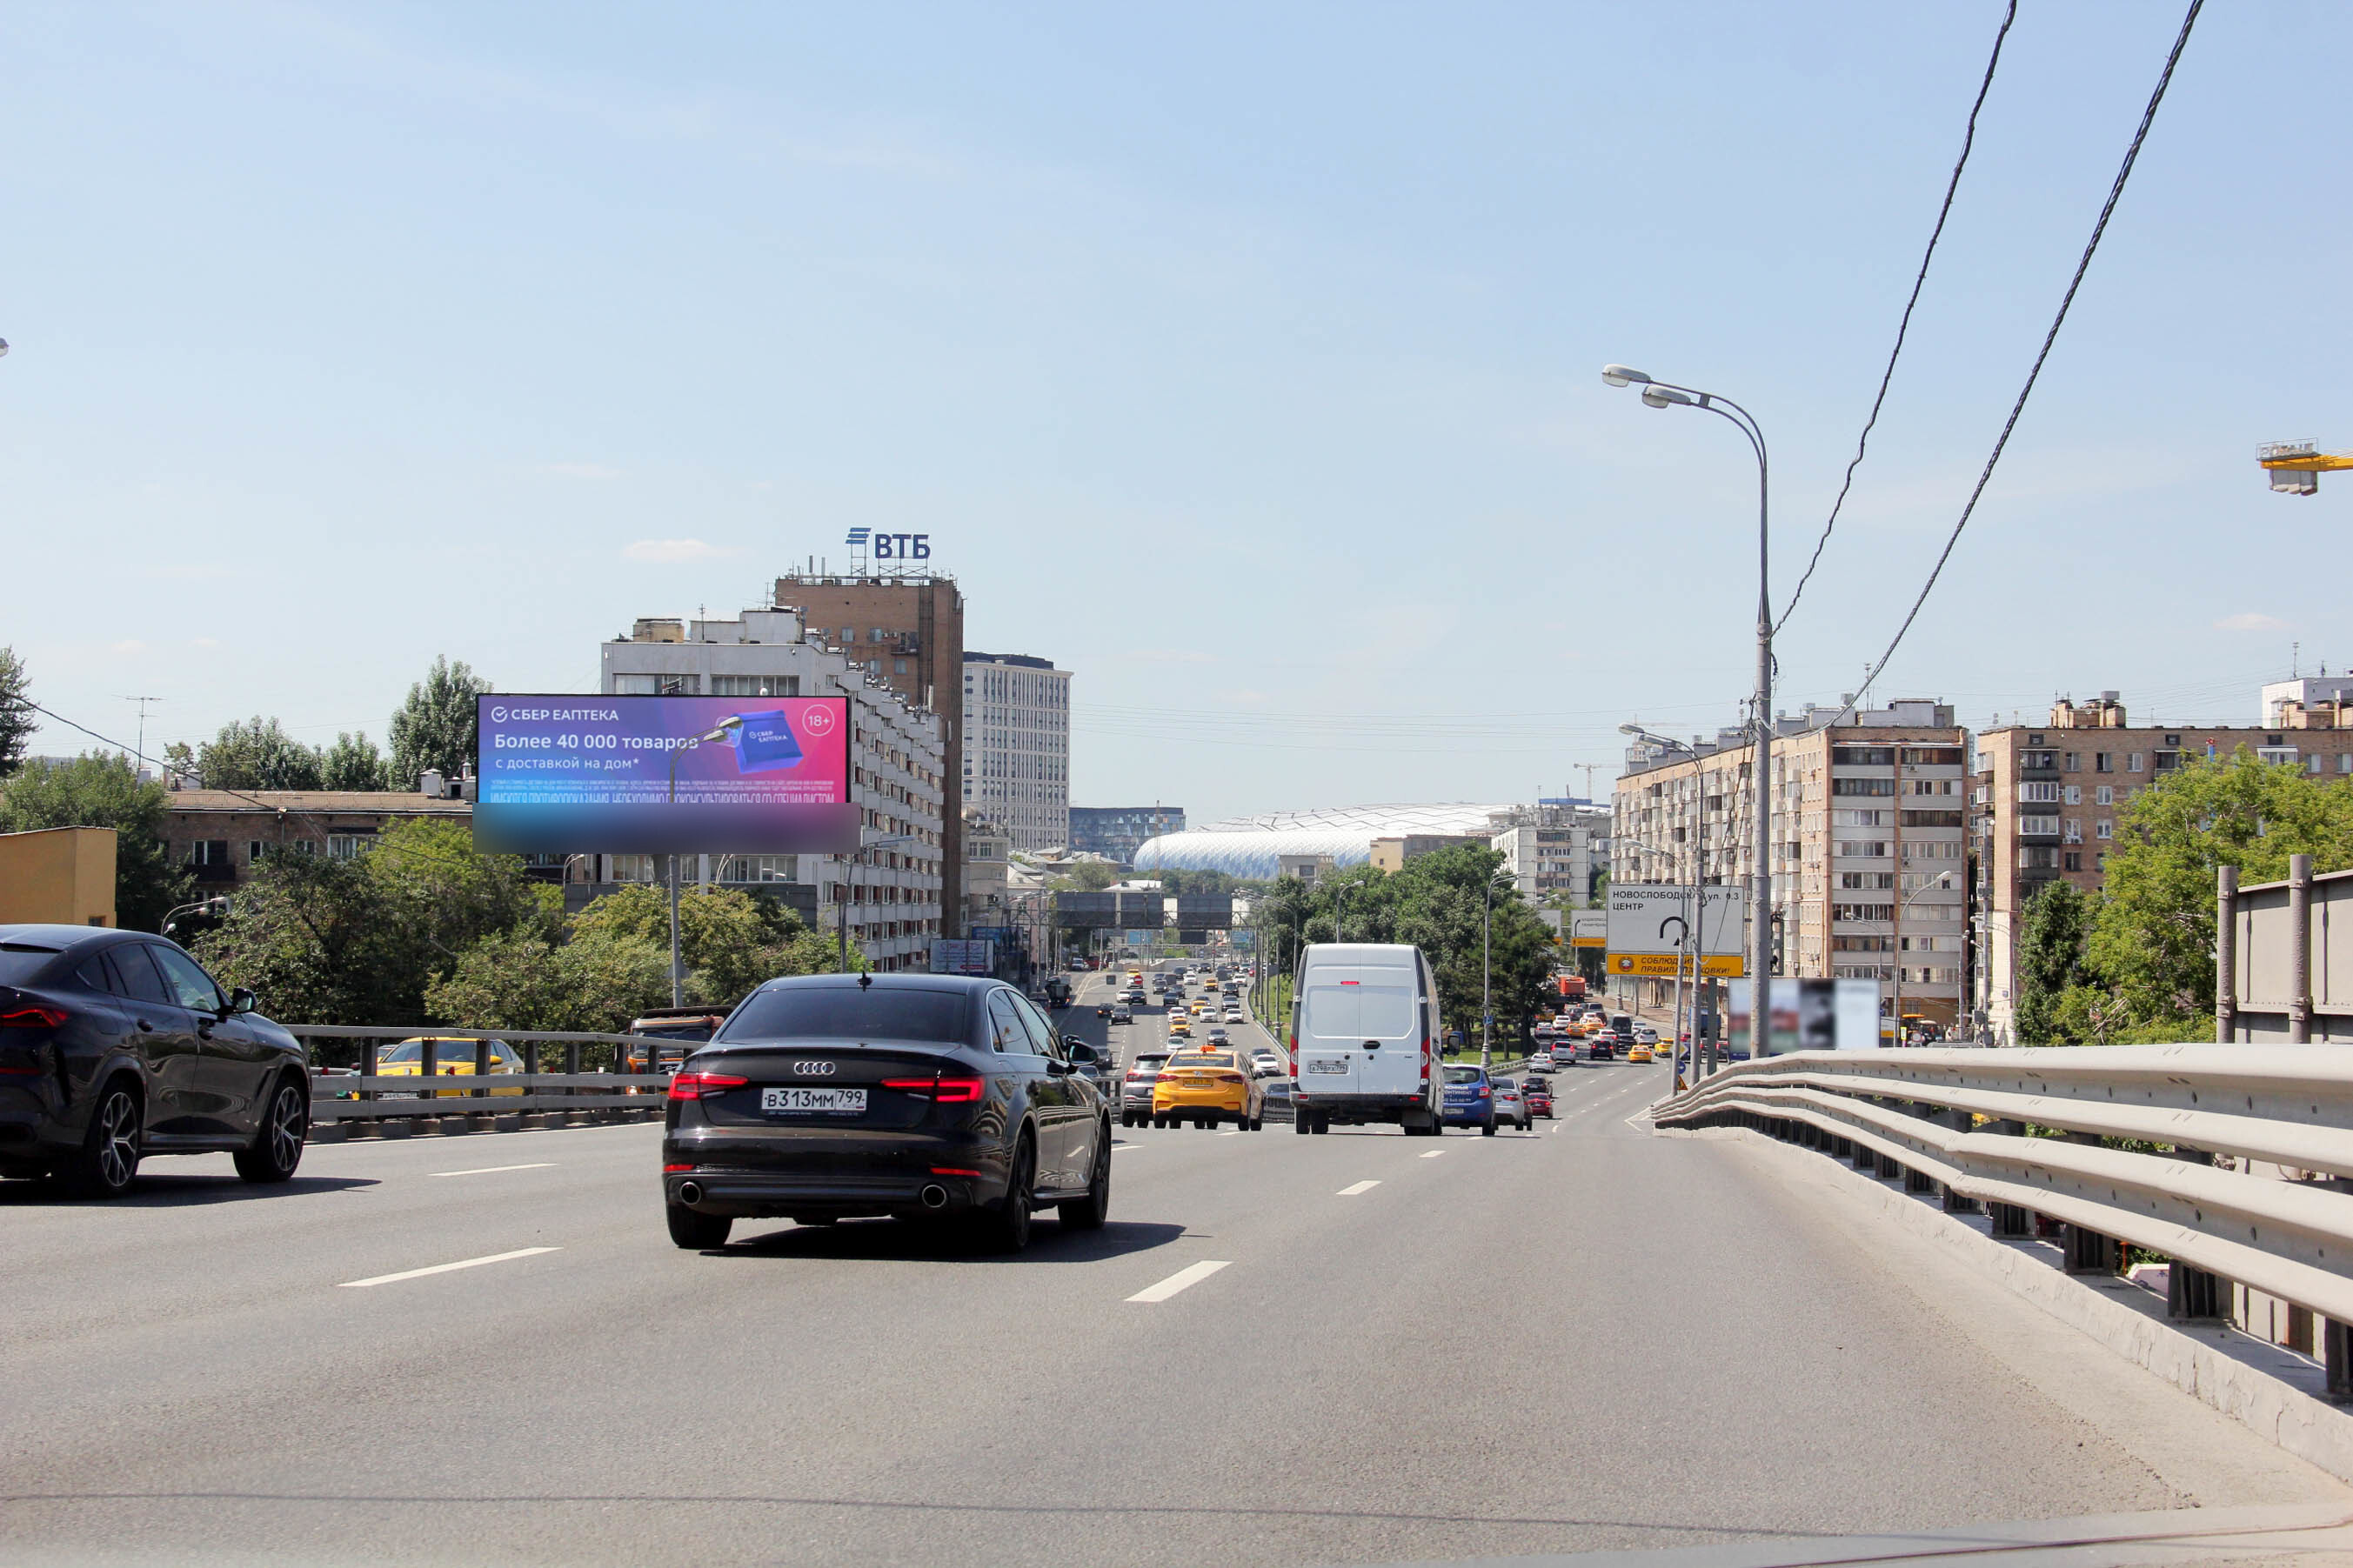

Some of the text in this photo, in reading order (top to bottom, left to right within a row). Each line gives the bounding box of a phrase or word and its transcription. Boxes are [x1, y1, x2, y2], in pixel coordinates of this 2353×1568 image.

[875, 533, 931, 559] ВТБ
[511, 709, 619, 721] СБЕР ЕАПТЕКА
[808, 715, 830, 727] 18+
[495, 734, 699, 751] Более 40 000 товаров
[495, 759, 503, 769] с
[506, 757, 579, 771] доставкой
[585, 759, 600, 769] на
[1613, 903, 1644, 911] ЦЕНТР
[838, 1090, 863, 1103] 799
